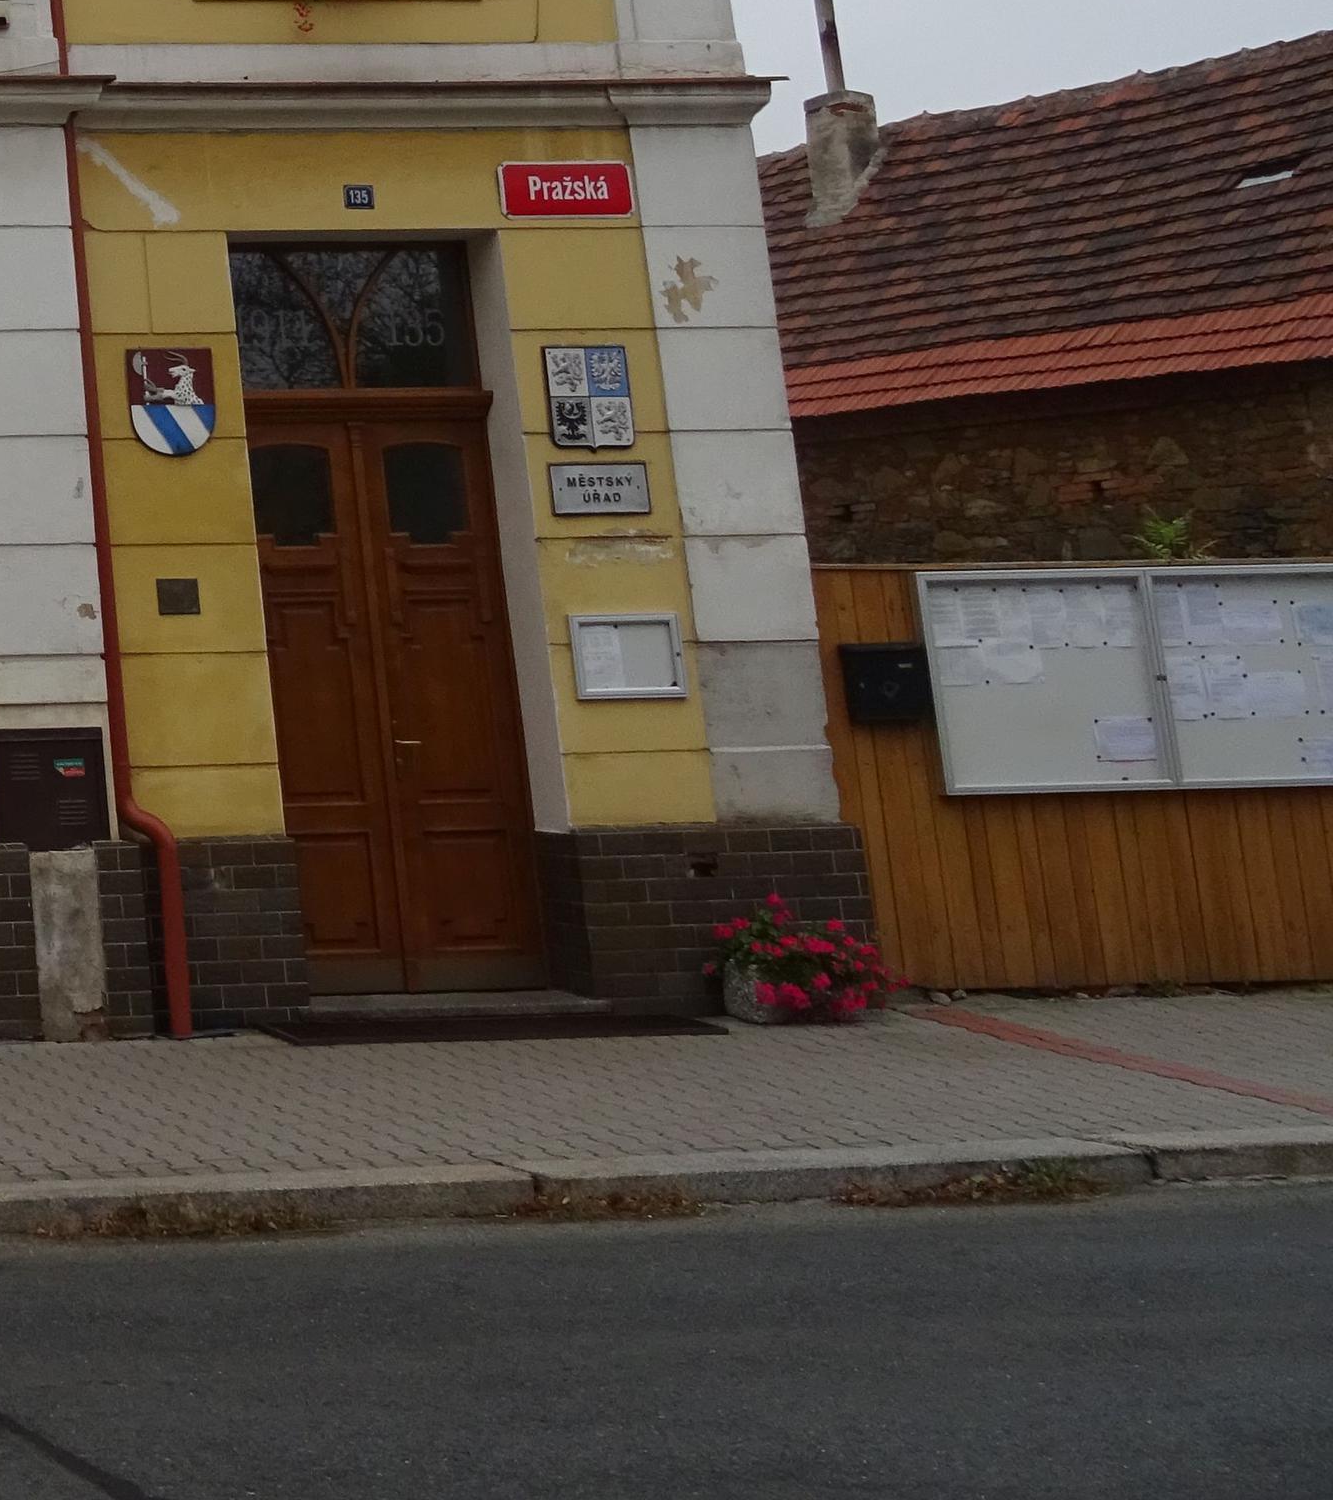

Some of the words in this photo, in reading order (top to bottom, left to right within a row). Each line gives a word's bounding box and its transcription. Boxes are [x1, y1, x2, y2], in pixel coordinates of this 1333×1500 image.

[527, 176, 609, 200] Pražská
[349, 190, 368, 204] 135
[386, 309, 445, 347] 135
[566, 473, 632, 487] MĚSTSKÝ
[583, 489, 621, 503] ÚŘAD
